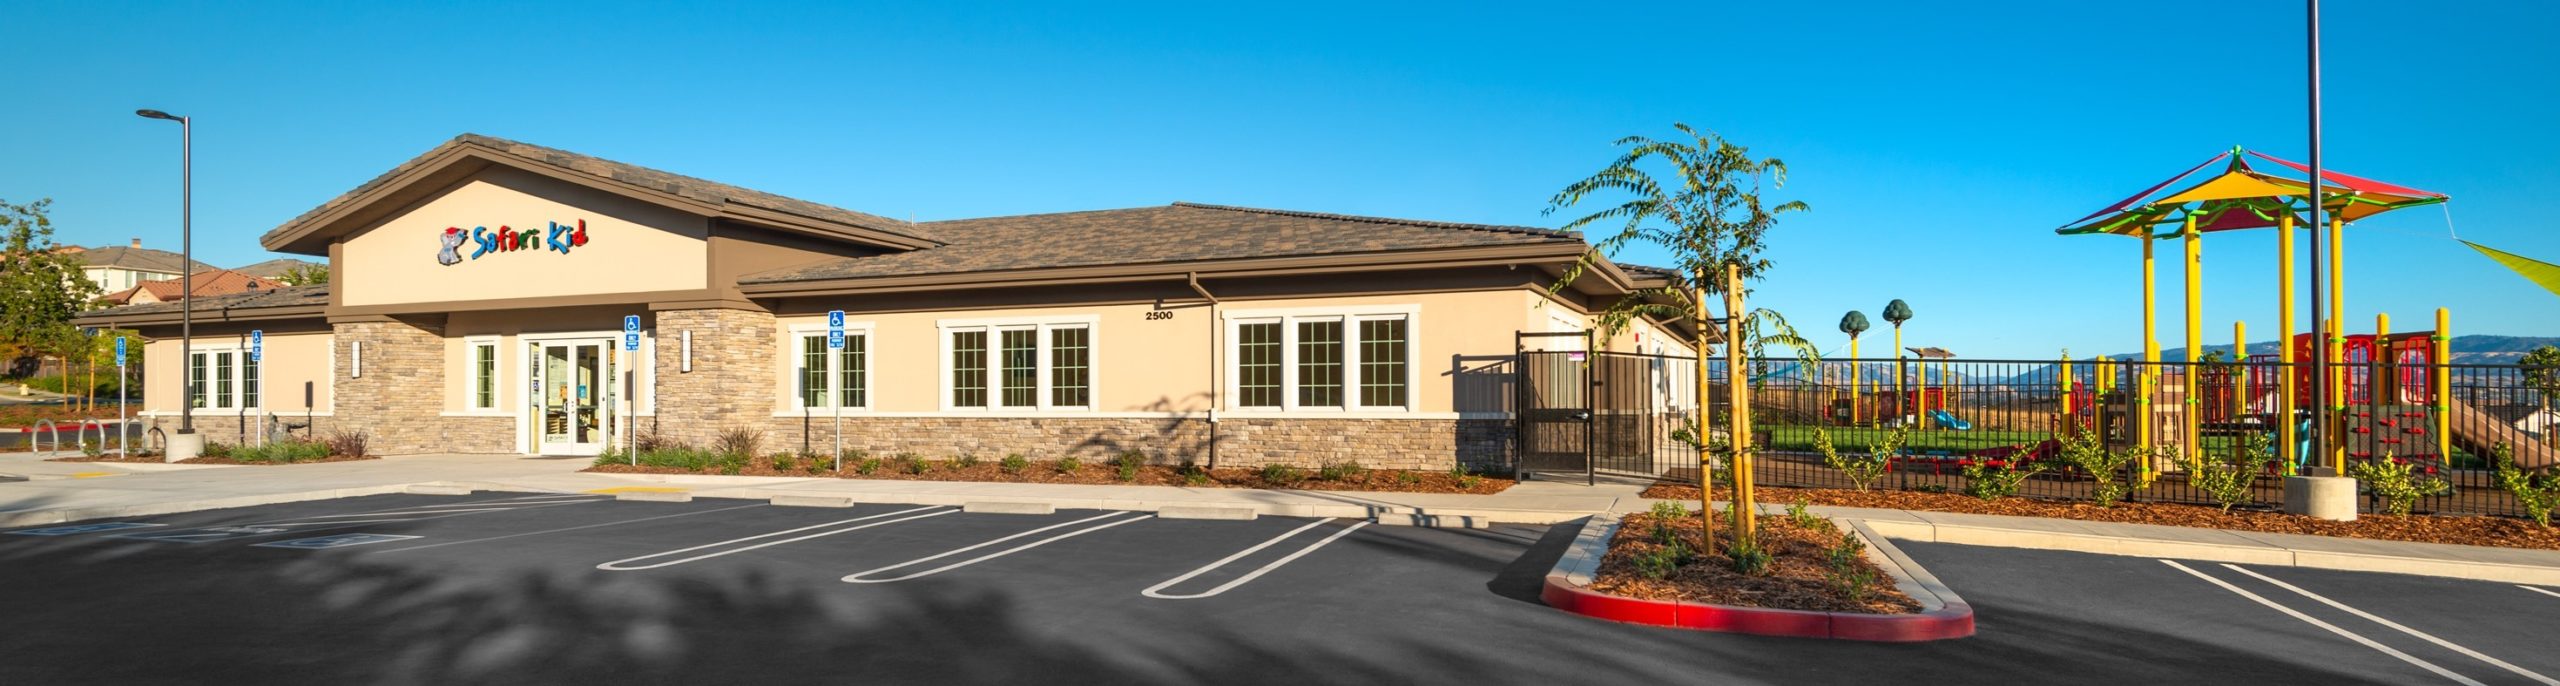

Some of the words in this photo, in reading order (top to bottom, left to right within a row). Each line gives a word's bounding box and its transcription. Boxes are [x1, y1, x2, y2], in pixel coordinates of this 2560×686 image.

[471, 225, 541, 260] Safari
[546, 218, 589, 254] Kid
[1145, 311, 1173, 320] 2500
